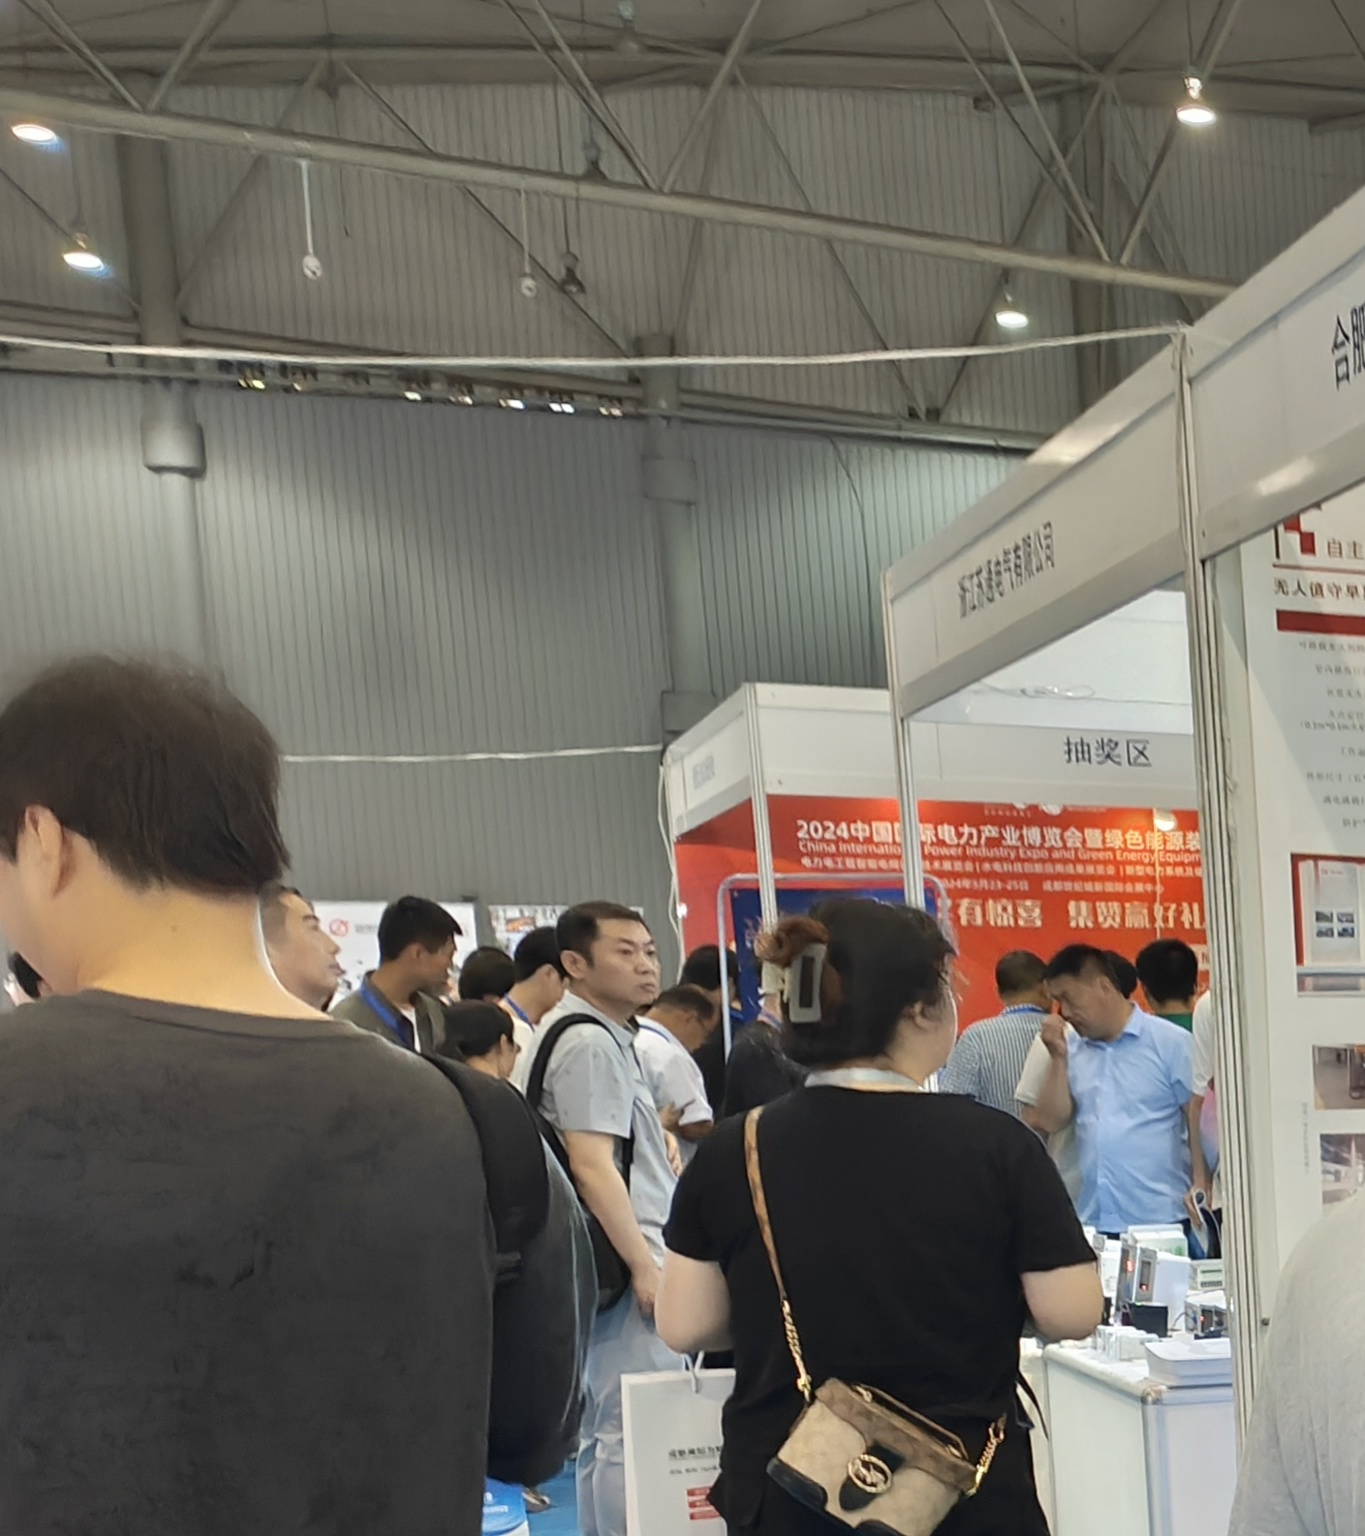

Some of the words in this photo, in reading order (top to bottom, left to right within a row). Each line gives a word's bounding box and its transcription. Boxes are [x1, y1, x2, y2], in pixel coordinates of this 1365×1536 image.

[1062, 736, 1153, 768] 抽奖区
[796, 819, 1201, 851] 2024中国际电力产业博览会暨绿色能源装
[799, 840, 836, 854] China
[924, 845, 962, 858] Power
[966, 847, 1017, 861] Industry
[1020, 849, 1049, 863] Expo
[1052, 850, 1075, 860] and
[1078, 849, 1113, 861] Green
[1116, 851, 1156, 865] Energy
